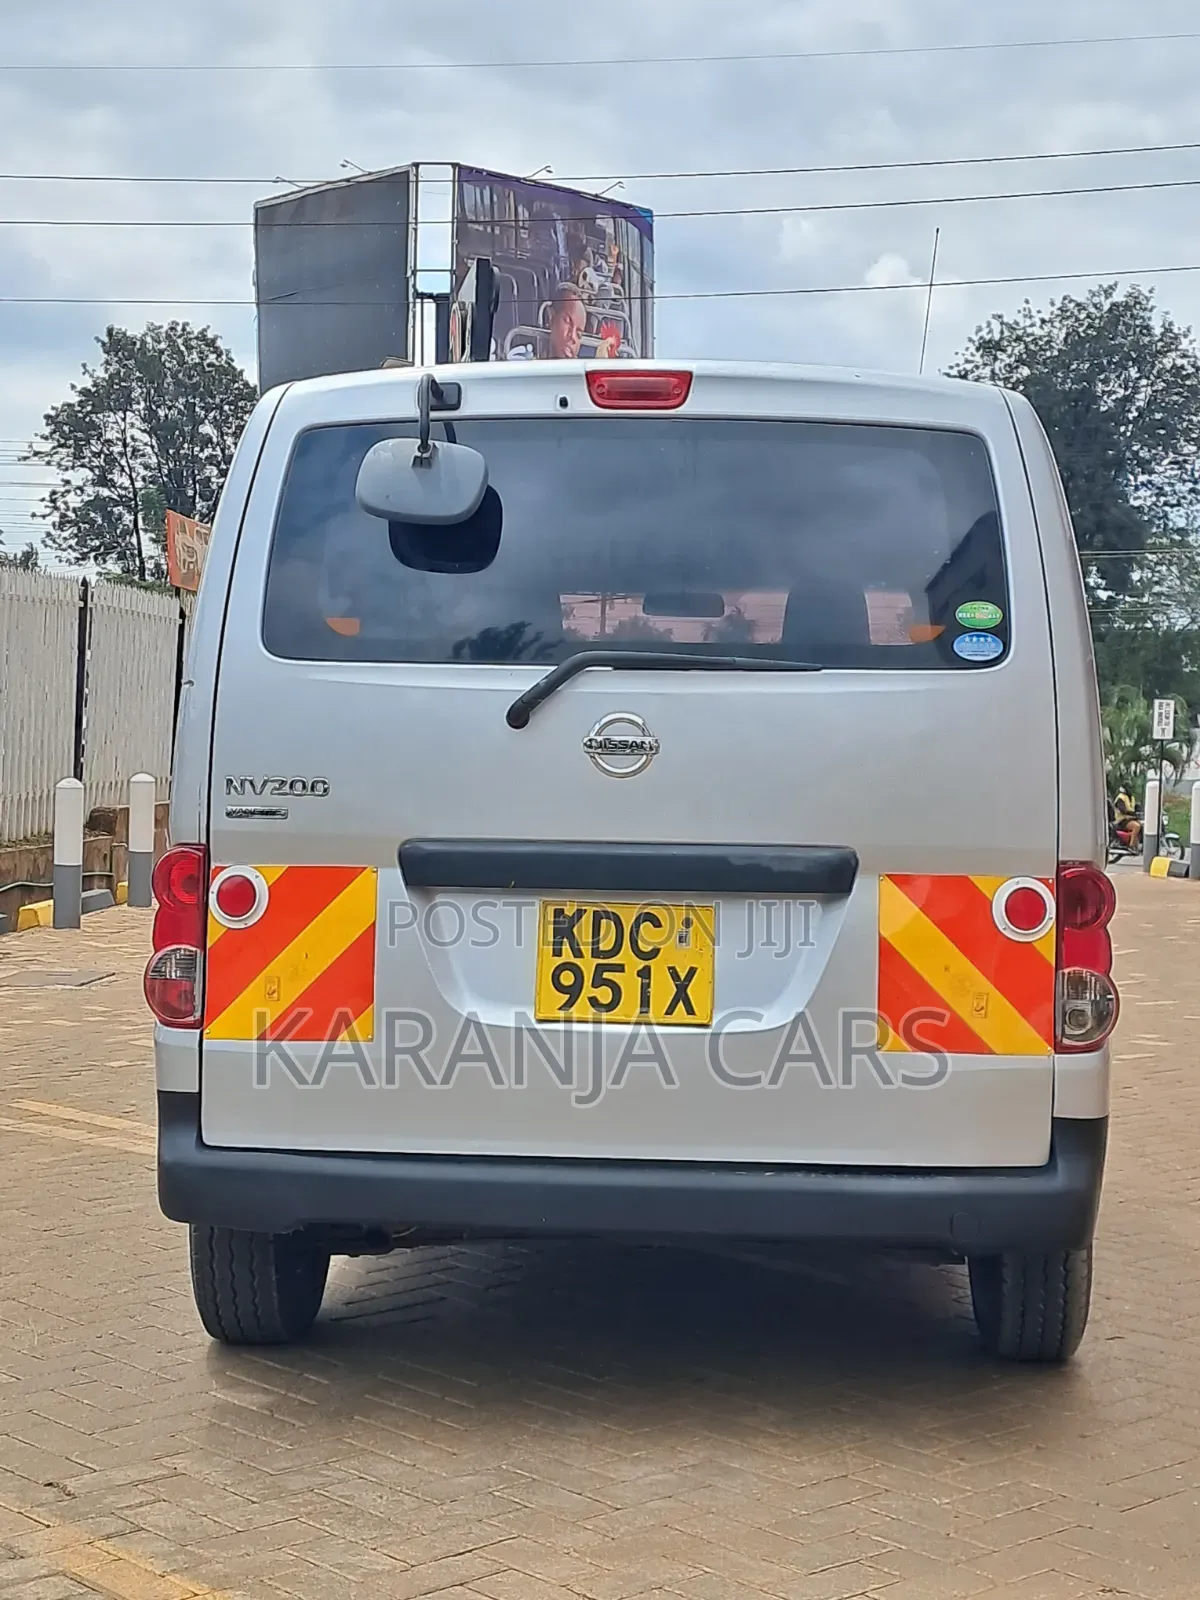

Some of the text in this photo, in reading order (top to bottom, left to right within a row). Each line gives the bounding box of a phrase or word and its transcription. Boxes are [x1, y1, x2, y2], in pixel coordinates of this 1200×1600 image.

[587, 738, 655, 751] NISSAN
[225, 775, 330, 797] NV200
[551, 907, 662, 962] KDC
[551, 961, 699, 1016] 951X
